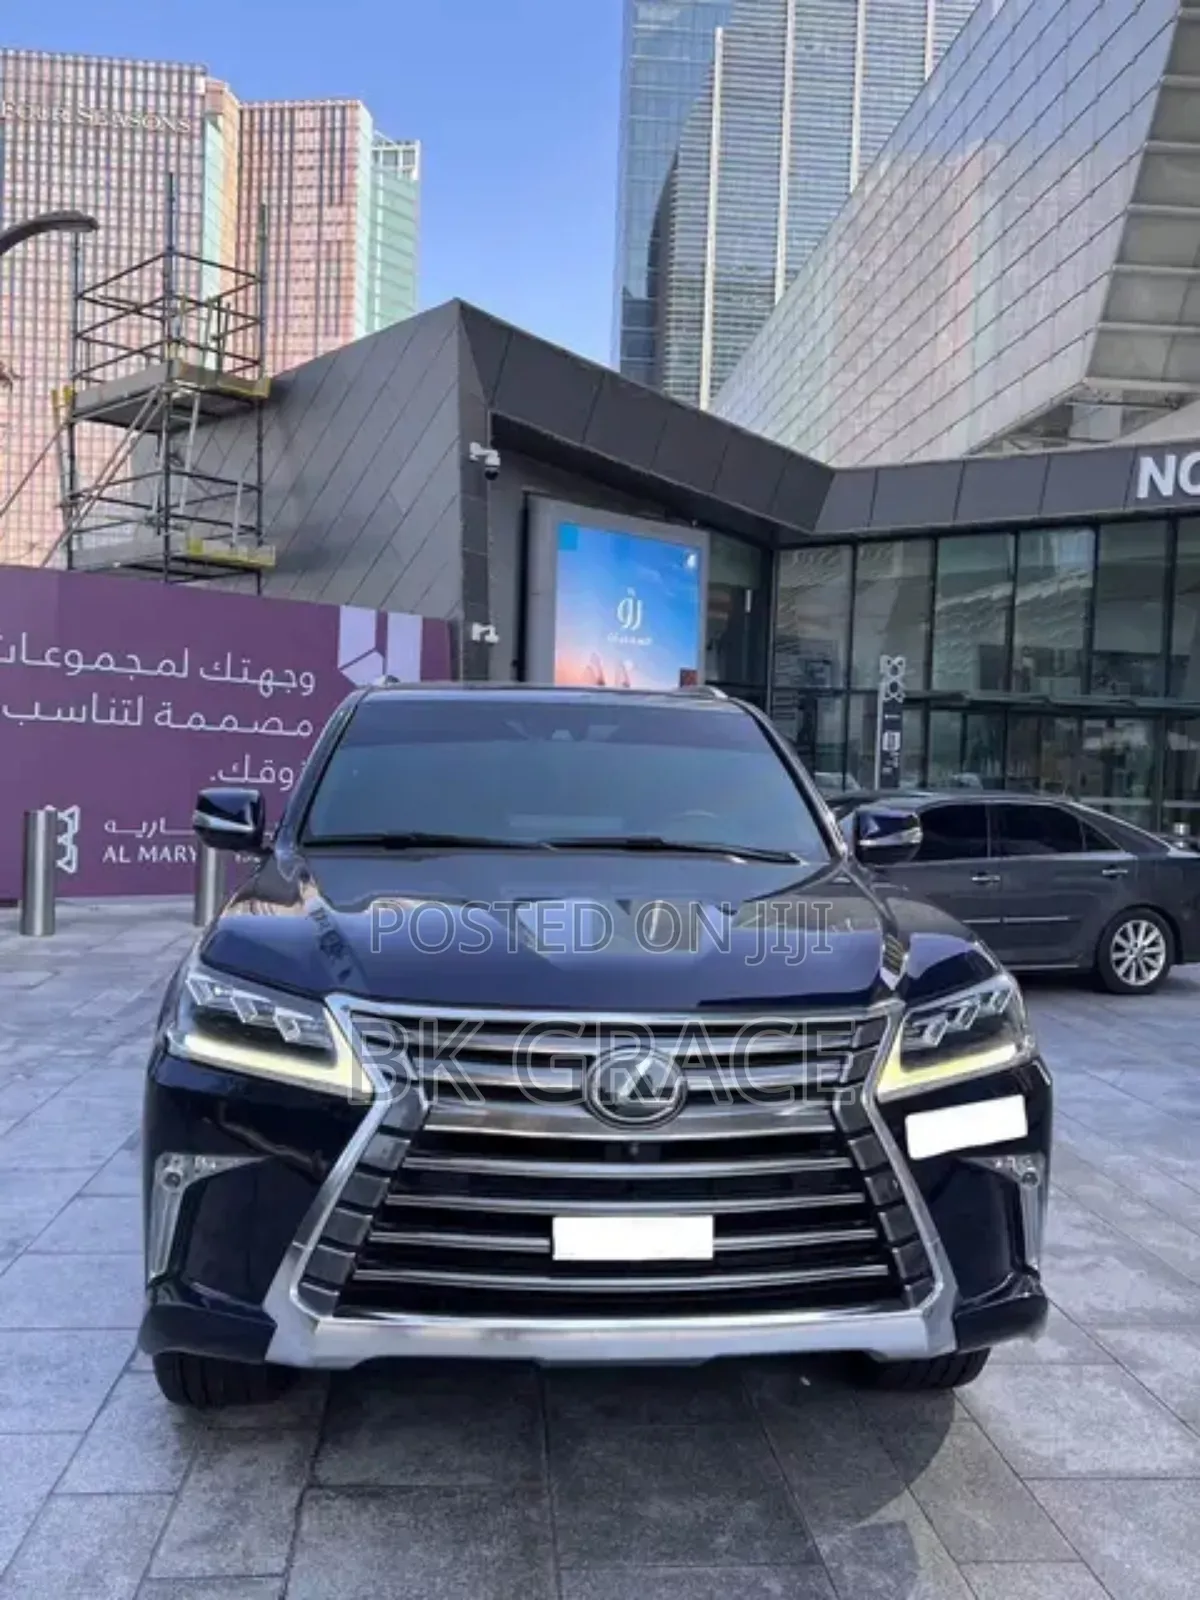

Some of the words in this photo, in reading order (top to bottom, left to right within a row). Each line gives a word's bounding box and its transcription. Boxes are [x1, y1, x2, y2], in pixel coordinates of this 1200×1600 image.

[199, 652, 316, 697] وجهتك
[2, 692, 144, 726] لتناسب
[154, 701, 313, 736] مصممة
[209, 753, 307, 791] وقك.
[102, 844, 131, 863] AL
[137, 844, 198, 863] MARY
